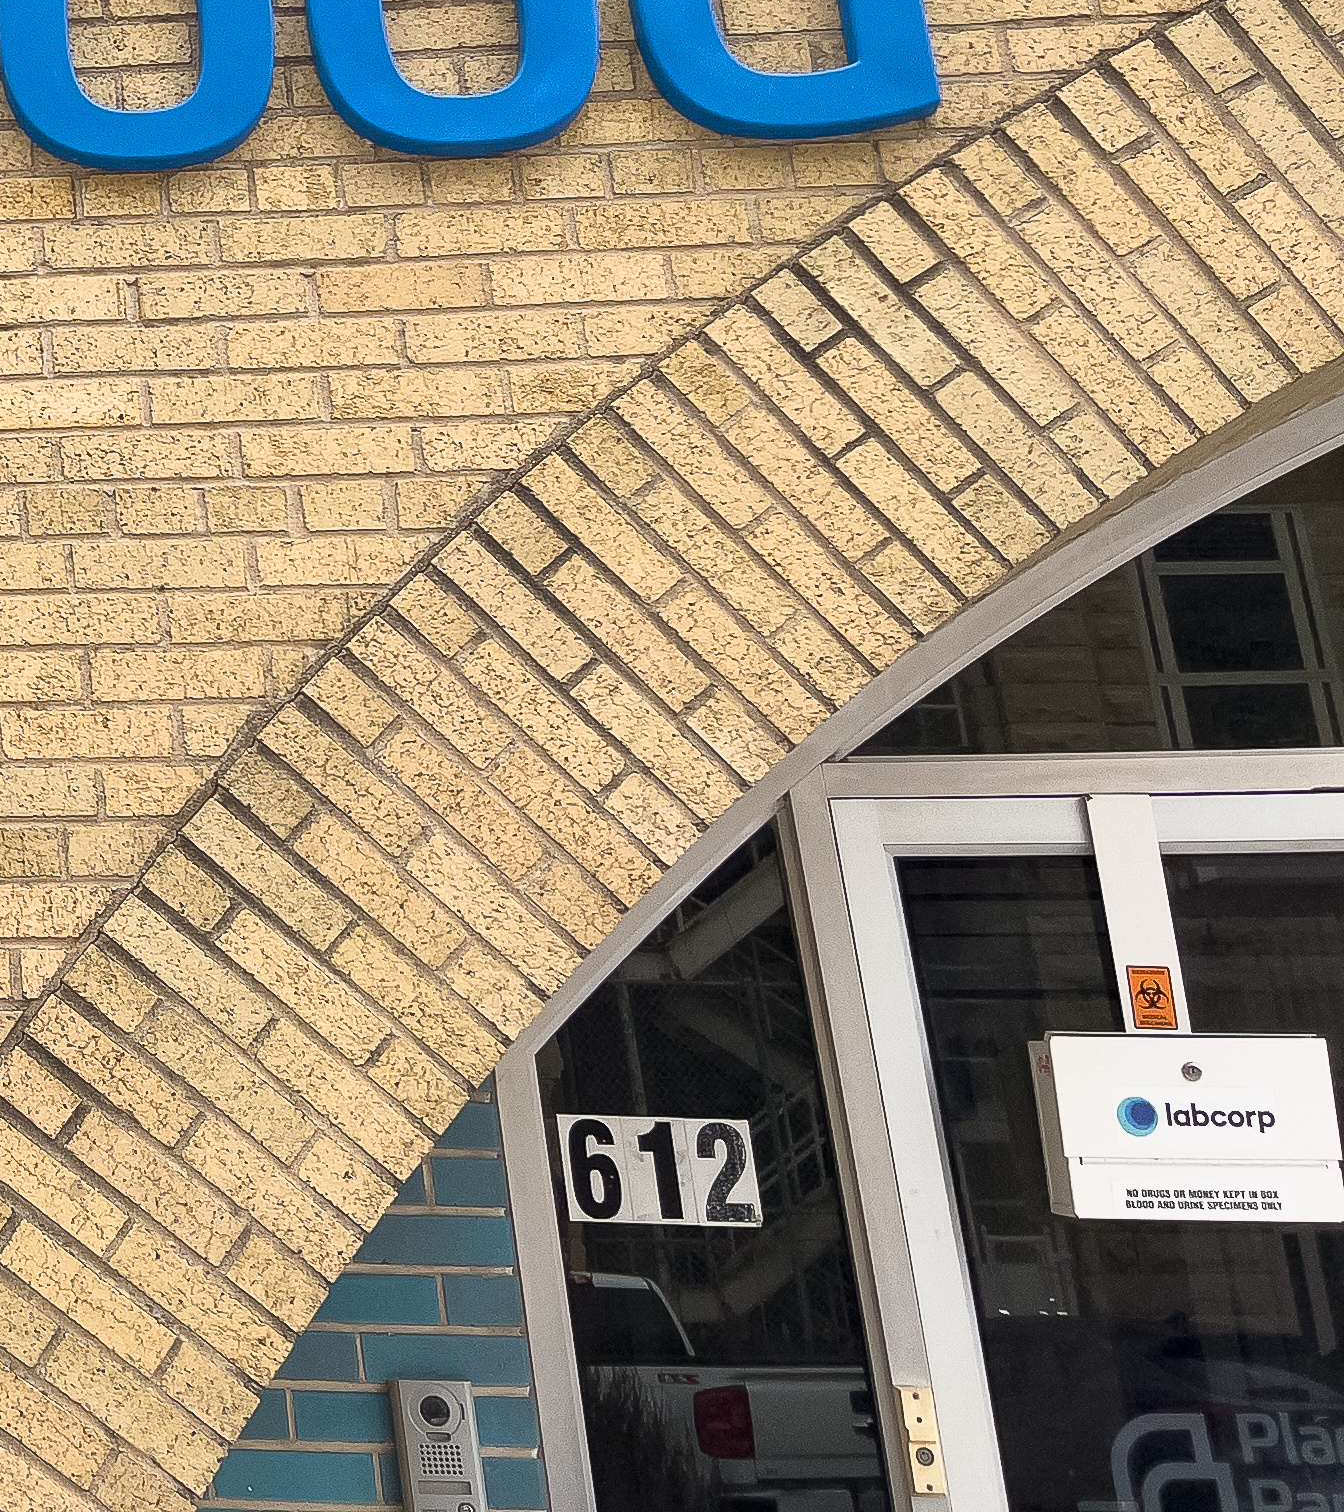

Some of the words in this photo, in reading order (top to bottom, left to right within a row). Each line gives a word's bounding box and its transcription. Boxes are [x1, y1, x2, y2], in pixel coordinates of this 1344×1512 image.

[1164, 1102, 1277, 1134] labcorp
[567, 1117, 757, 1224] 612
[1141, 1188, 1171, 1199] DRUGS
[1188, 1189, 1220, 1199] MONEY
